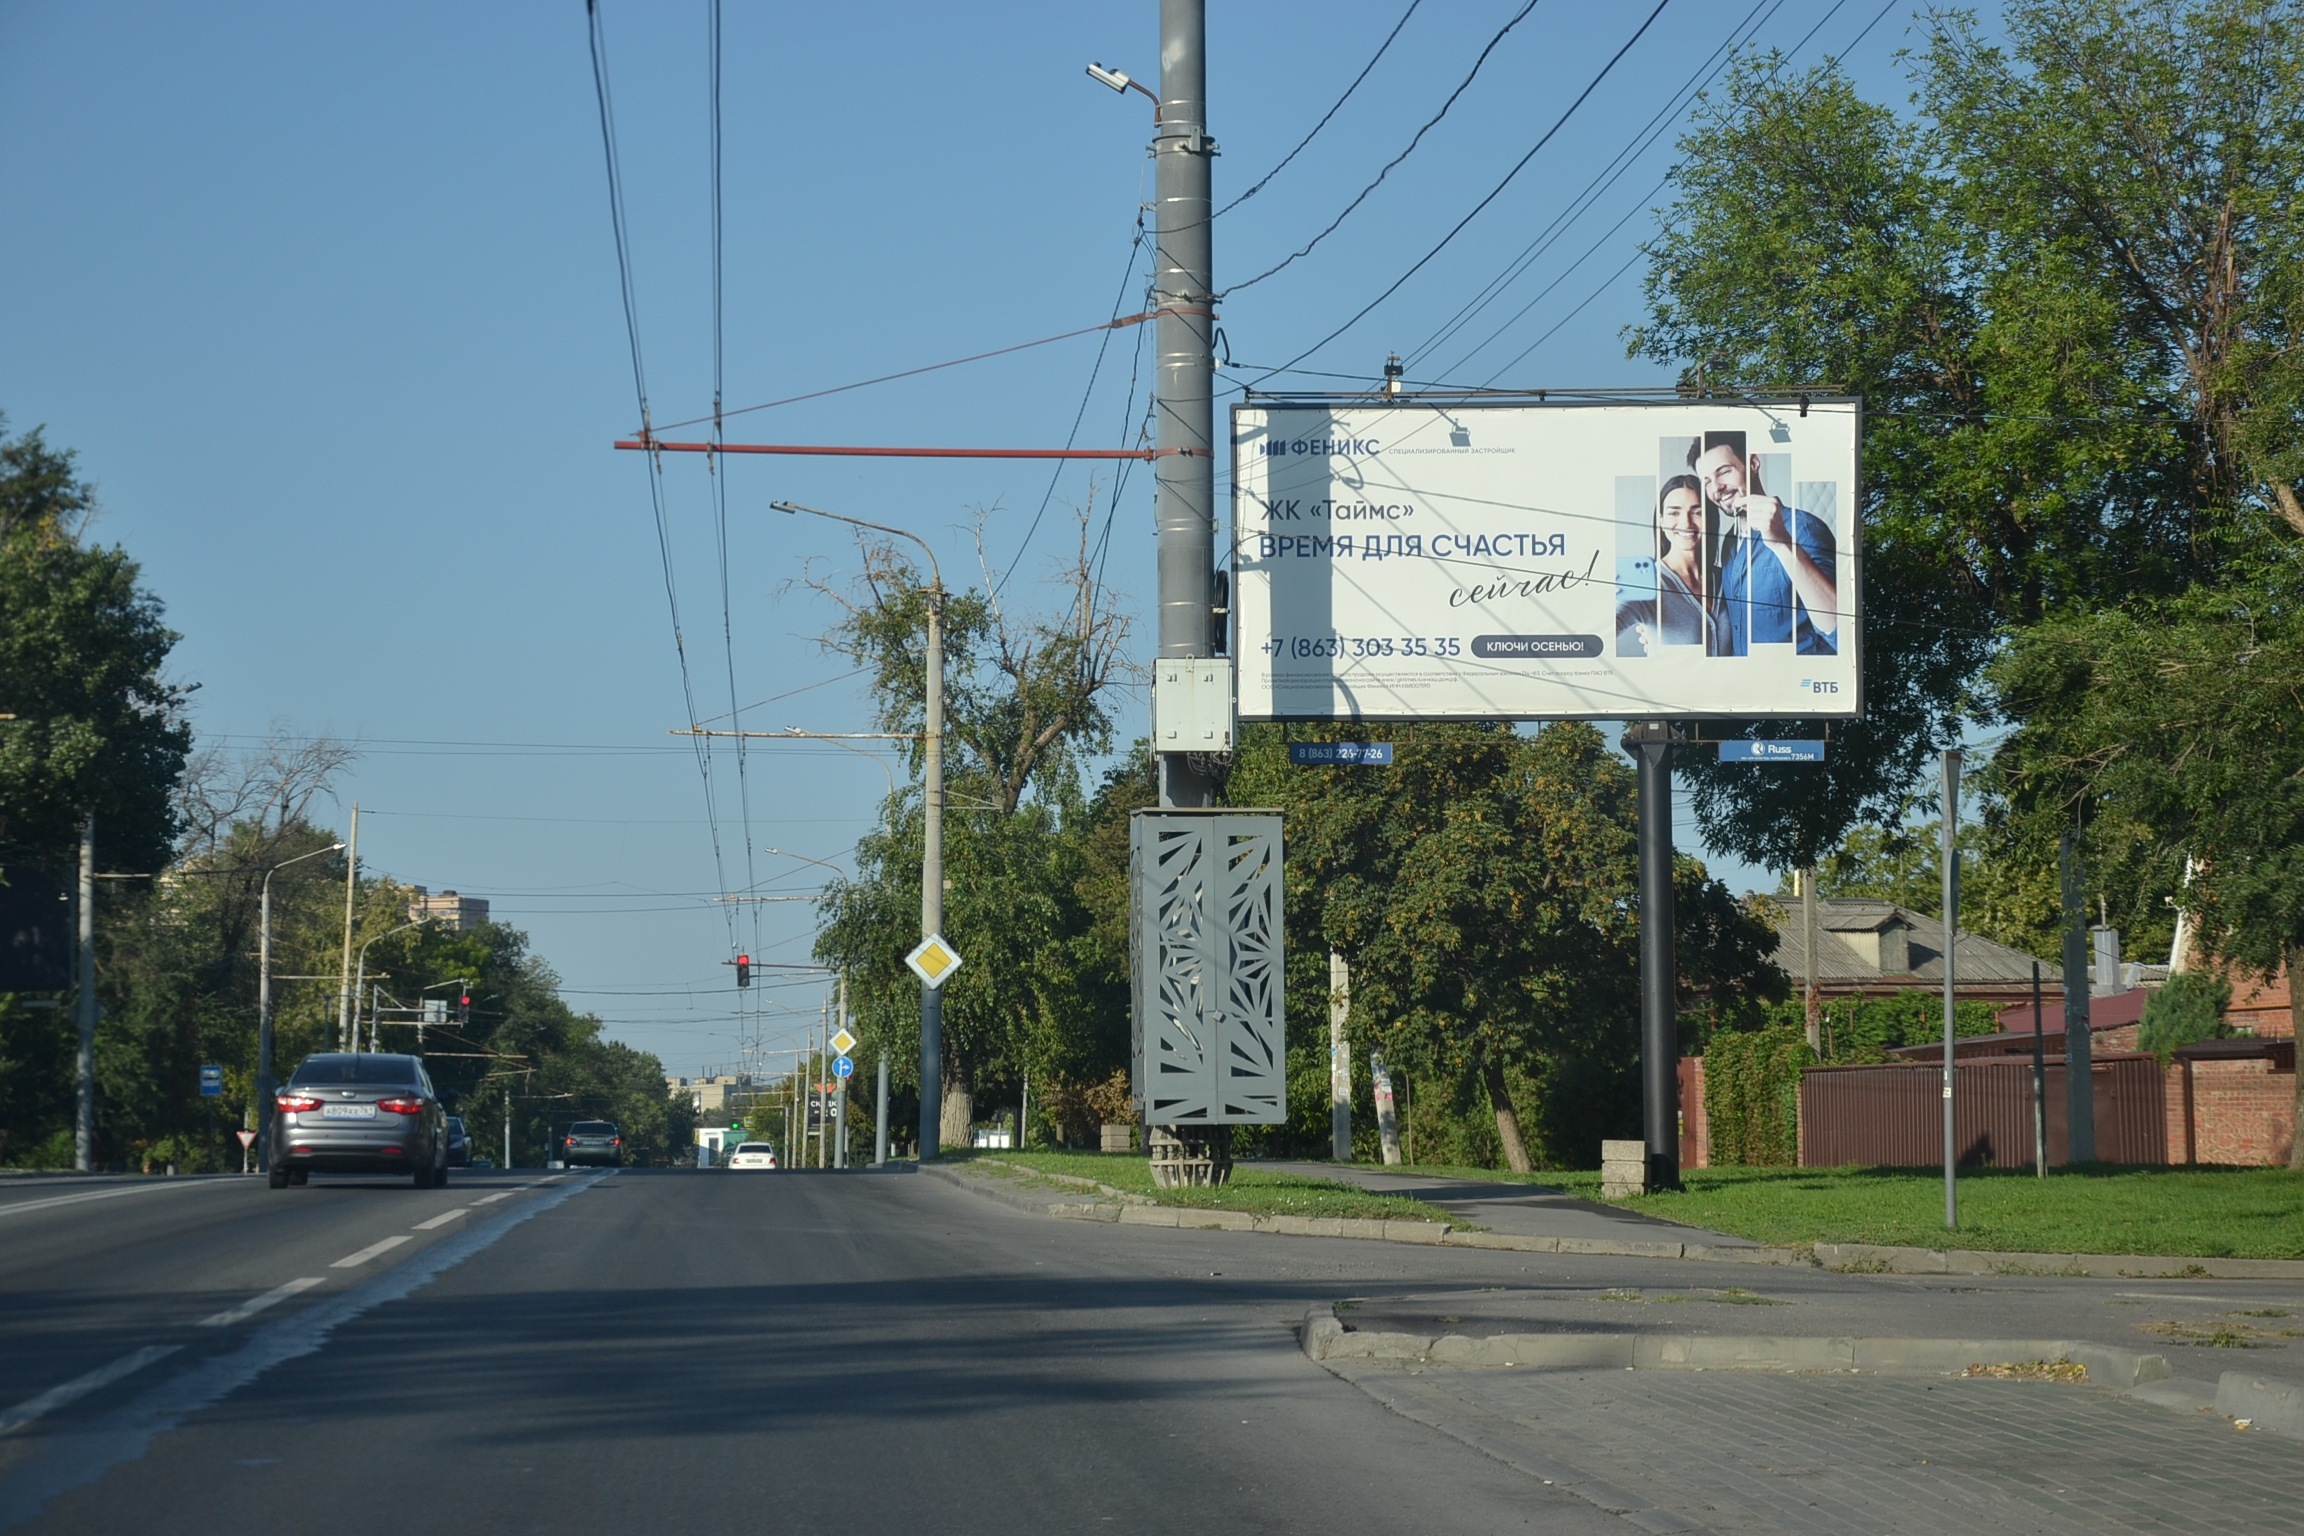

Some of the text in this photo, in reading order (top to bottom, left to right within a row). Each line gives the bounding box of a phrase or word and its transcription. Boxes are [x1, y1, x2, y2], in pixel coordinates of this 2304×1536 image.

[1291, 439, 1380, 456] ФЕНИКС
[1261, 500, 1414, 520] ЖК «Таймс»
[1260, 533, 1565, 561] ВРЕМЯ ДЛЯ СЧАСТЬЯ
[1449, 549, 1600, 607] сейчас!
[1261, 636, 1461, 659] +7 (863) 303 35 35
[1487, 641, 1584, 652] КЛЮЧИ ОСЕНЬЮ!
[1813, 681, 1838, 693] ВТБ
[1299, 747, 1383, 759] 8 (863) 226-77-26
[1767, 744, 1792, 753] Russ
